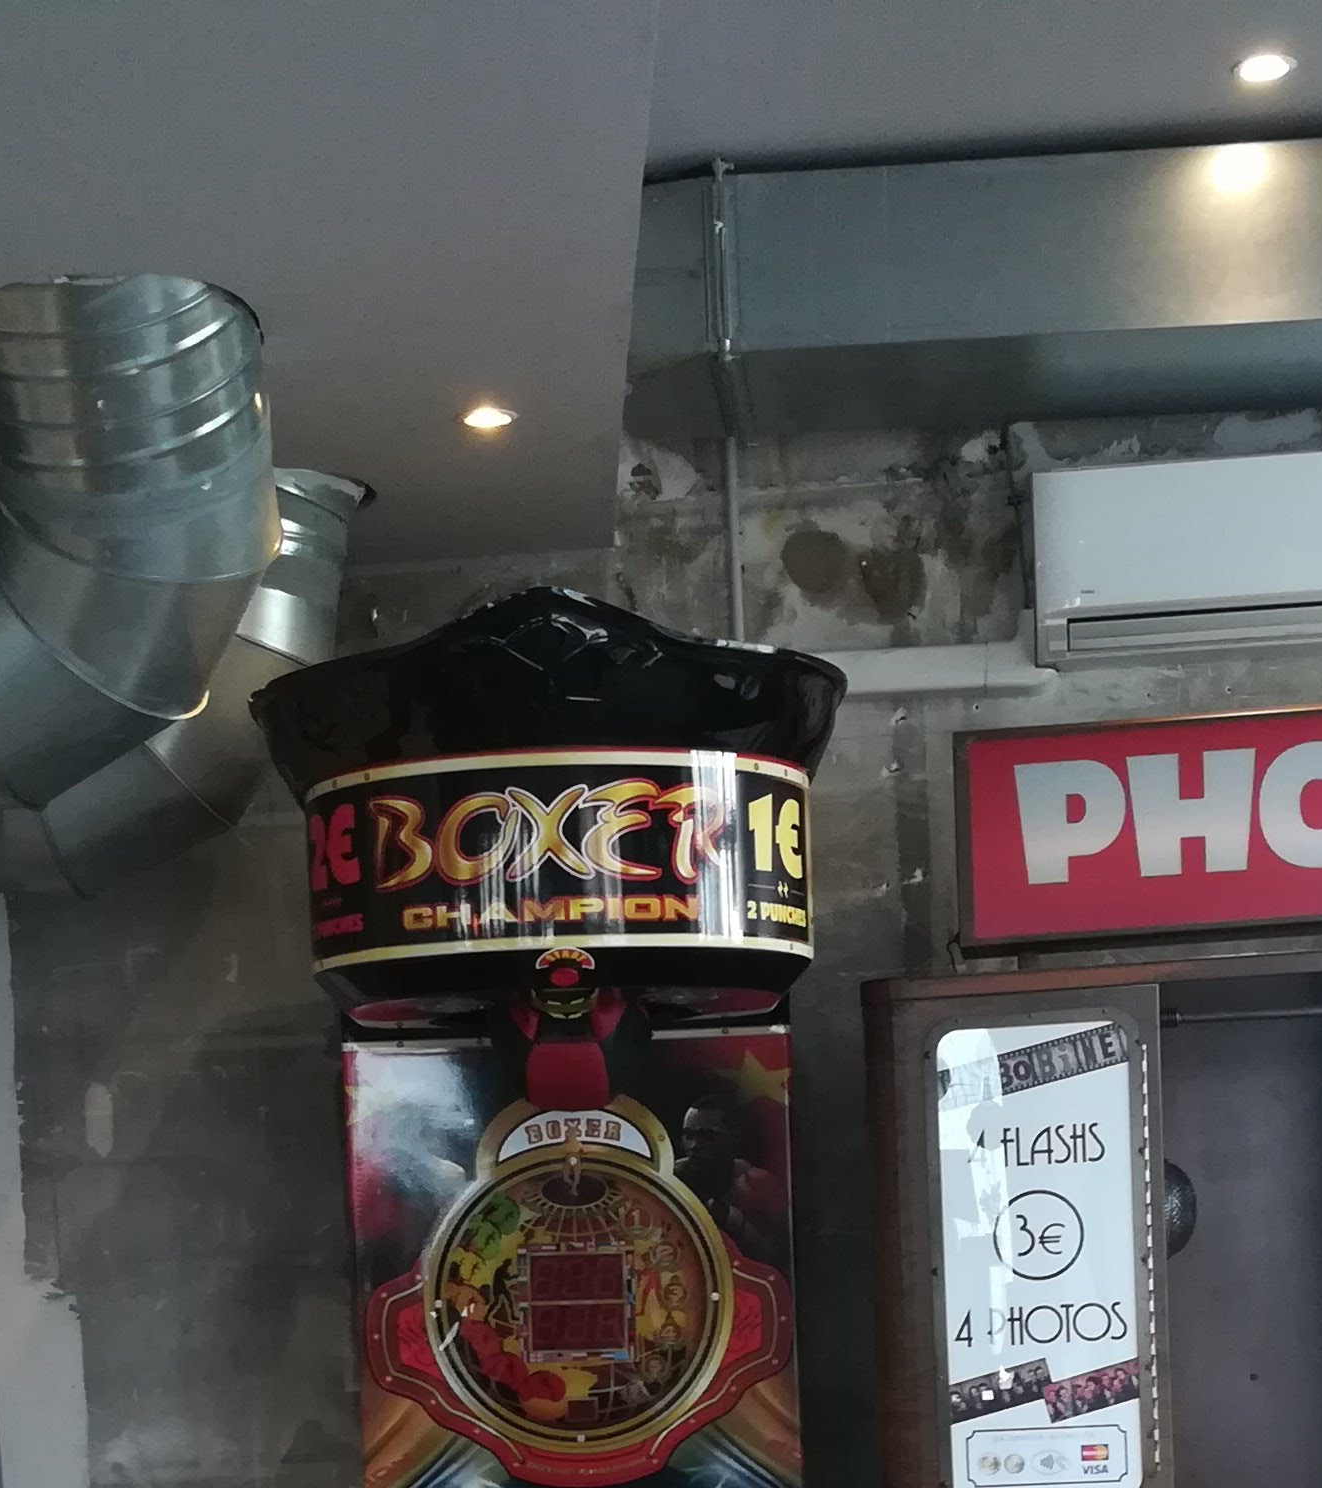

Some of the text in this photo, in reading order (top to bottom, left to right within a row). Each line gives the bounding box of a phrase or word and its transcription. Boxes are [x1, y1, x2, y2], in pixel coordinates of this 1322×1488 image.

[369, 778, 729, 893] BOXER
[748, 793, 804, 880] 1€
[402, 894, 701, 932] CHAMPION
[747, 900, 758, 920] 2
[525, 1118, 622, 1145] BOXER
[1000, 1122, 1106, 1167] FLASHS
[1016, 1214, 1066, 1257] 3€
[954, 1301, 1128, 1347] 4 PHOTOS
[1082, 1464, 1109, 1475] VISA
